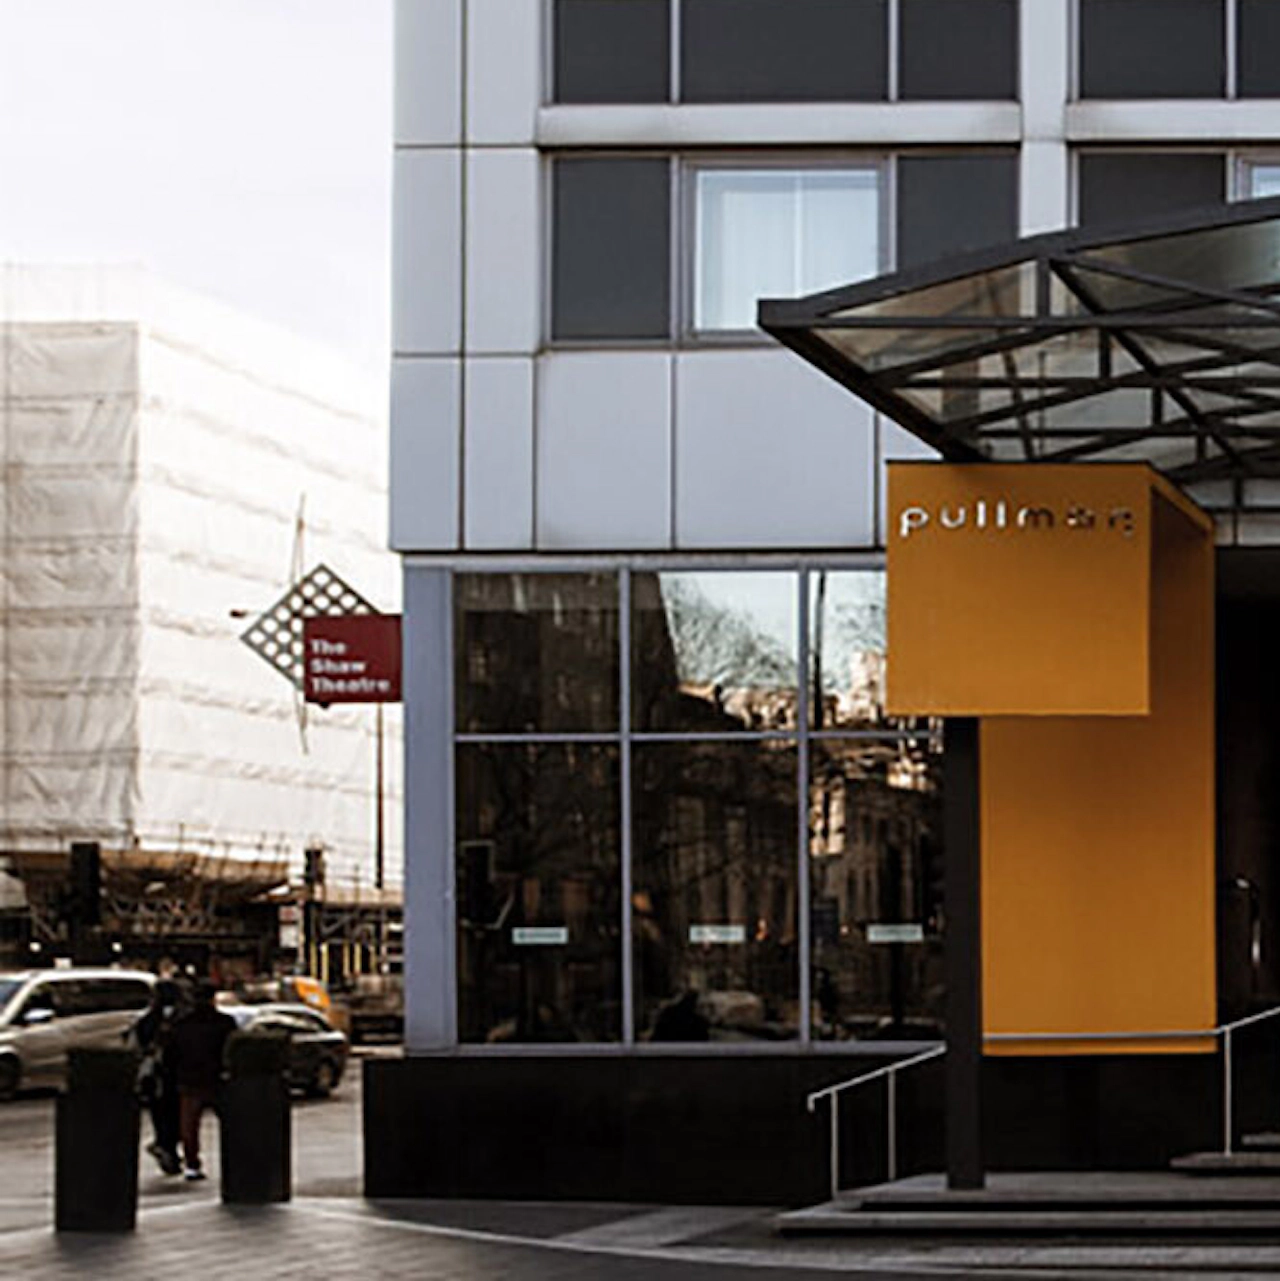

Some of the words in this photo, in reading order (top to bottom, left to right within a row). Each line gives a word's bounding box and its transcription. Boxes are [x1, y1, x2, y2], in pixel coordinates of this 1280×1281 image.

[310, 639, 346, 655] The
[311, 658, 366, 674] Shaw
[311, 677, 389, 693] Theatre
